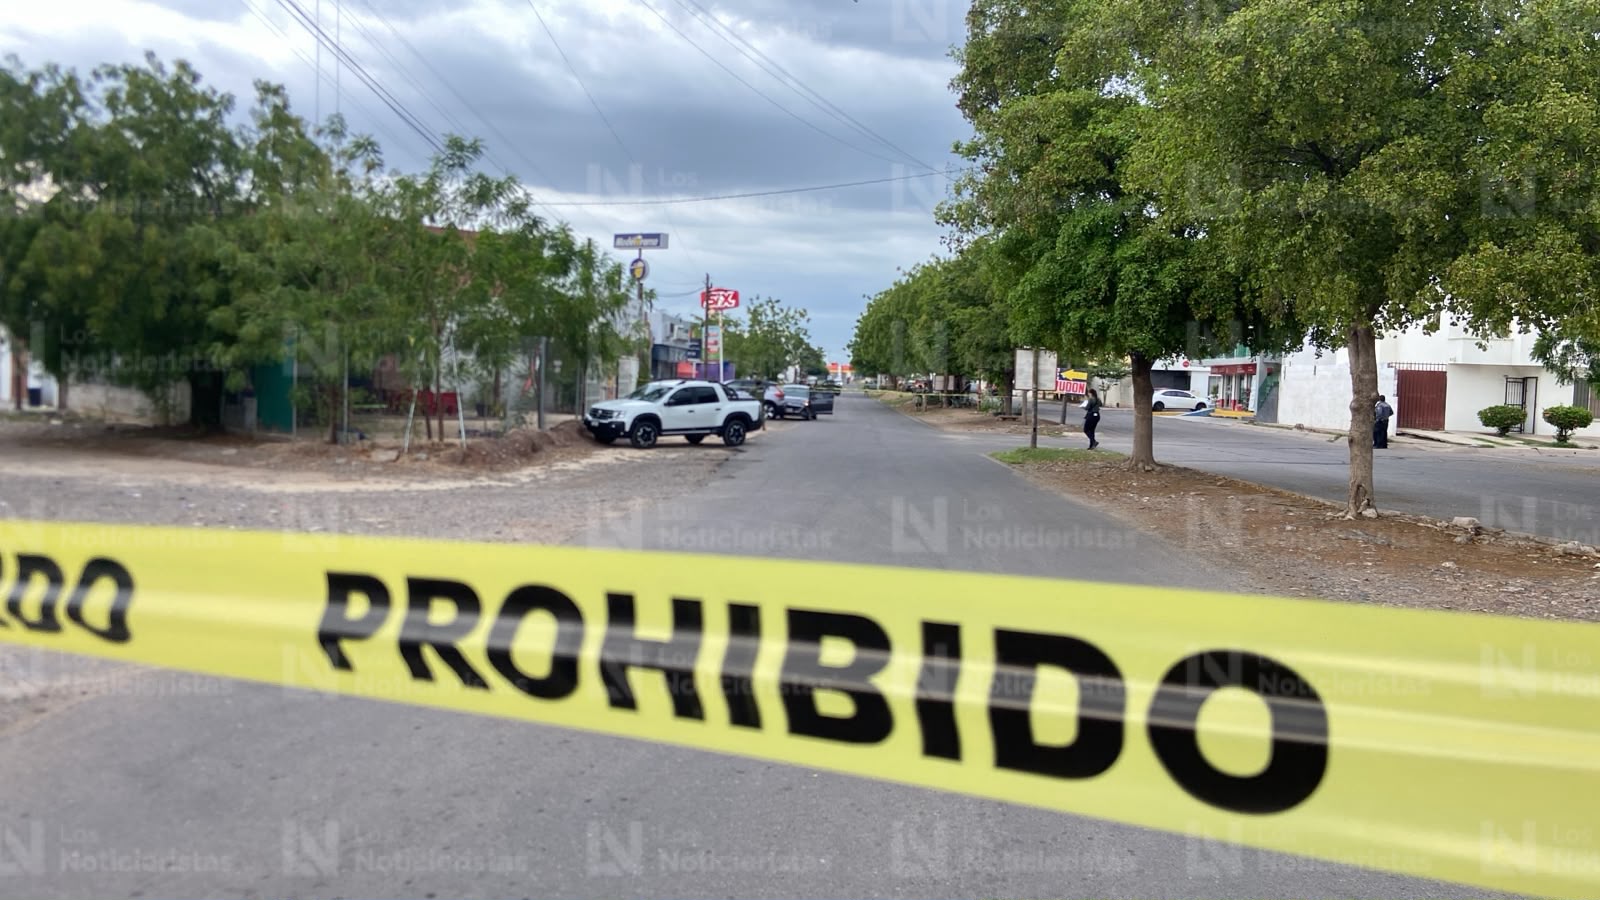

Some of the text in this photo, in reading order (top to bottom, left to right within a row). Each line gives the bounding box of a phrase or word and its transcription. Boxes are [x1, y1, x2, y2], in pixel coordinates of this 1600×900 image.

[1056, 381, 1085, 393] UDON
[0, 553, 134, 643] DO
[317, 570, 1331, 815] PROHIBIDO
